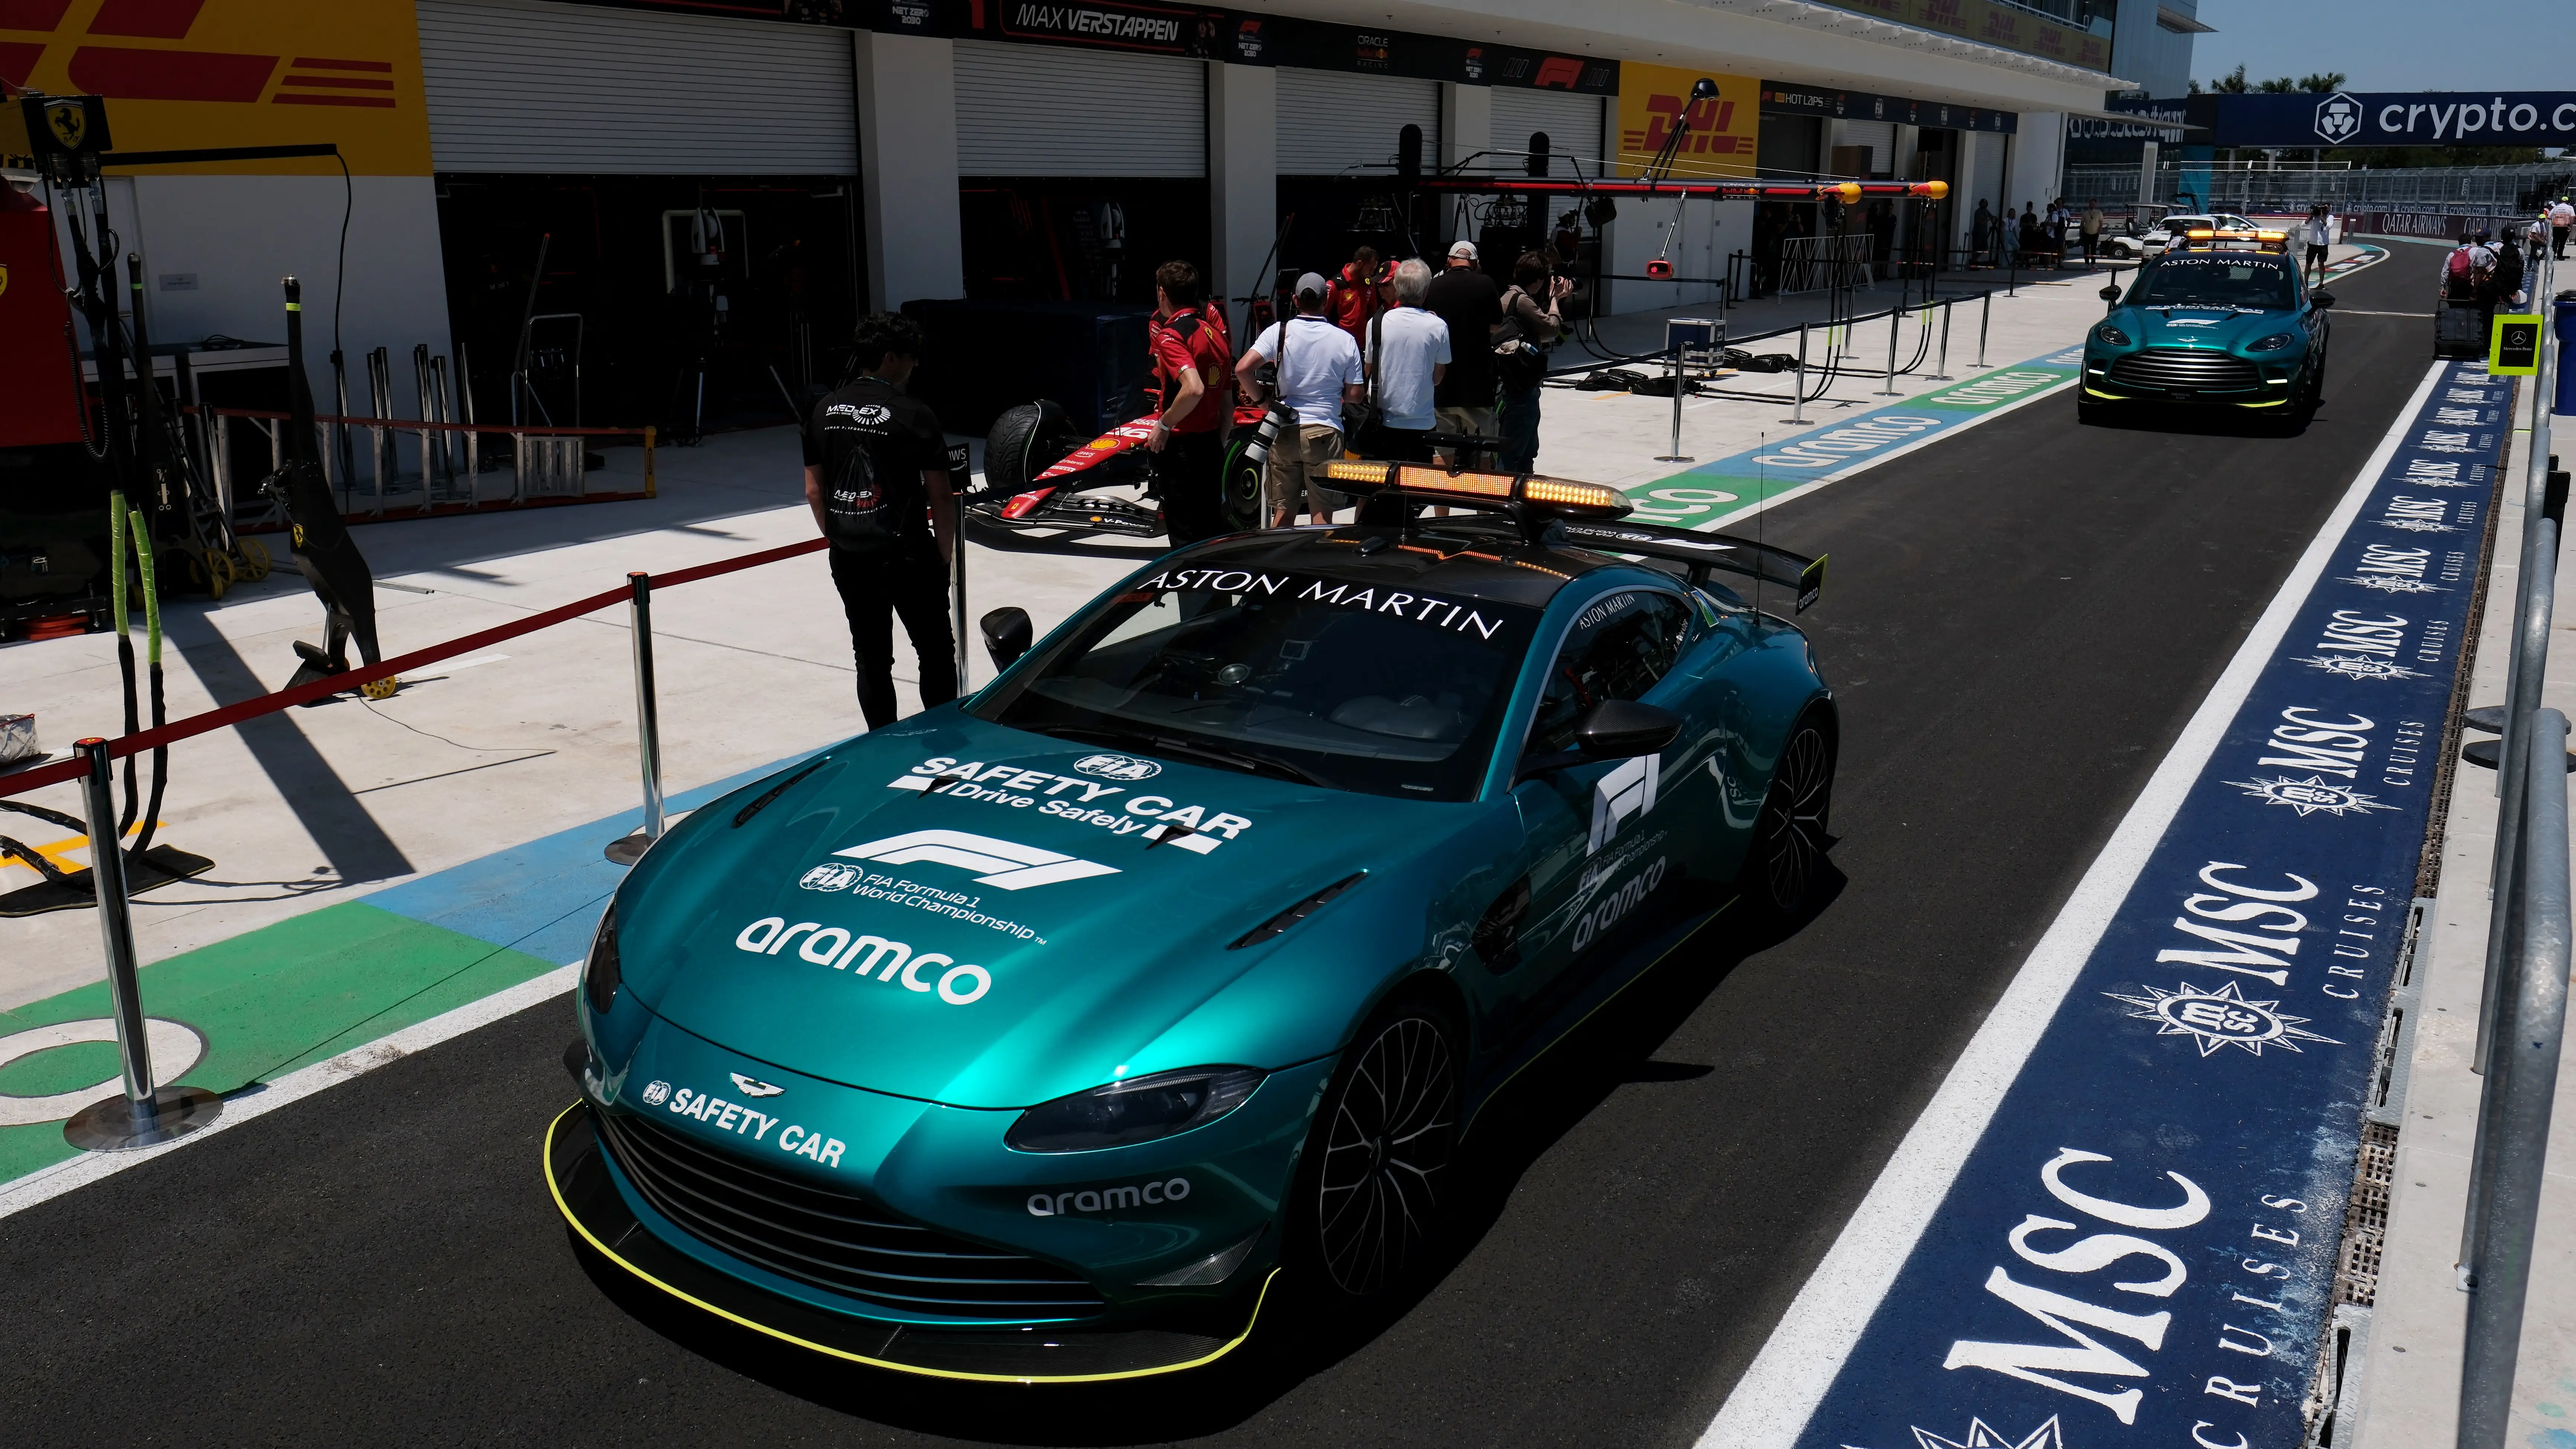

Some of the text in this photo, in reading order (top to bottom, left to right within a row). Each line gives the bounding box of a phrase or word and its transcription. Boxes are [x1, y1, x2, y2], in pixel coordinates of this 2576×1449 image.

[892, 6, 907, 15] NET
[902, 15, 921, 25] 2030
[1016, 3, 1179, 41] MAX VERSTAPPEN
[1358, 35, 1388, 47] ORACLE
[1357, 61, 1388, 69] RACING
[1785, 93, 1802, 104] HOT
[1643, 94, 1738, 153] DHL
[2383, 213, 2447, 235] QATAR AIRWAYS
[2450, 207, 2486, 215] crypo.com
[2160, 259, 2279, 270] ASTON MARTIN
[1930, 371, 2062, 406] aramco
[1751, 415, 1942, 468] aramco
[2406, 458, 2461, 479] MSC
[1015, 493, 1039, 502] antander
[2385, 495, 2448, 521] MSC
[2457, 501, 2477, 523] CRUISES
[1103, 518, 1152, 528] V-Power
[2357, 543, 2431, 578] MSC
[2440, 551, 2466, 582] CRUISES
[1137, 569, 1503, 640] ASTON MARTIN
[1579, 593, 1635, 630] ASTON MARTIN
[1799, 587, 1819, 610] aramco
[2317, 609, 2408, 658] MSC
[2417, 619, 2449, 662] CRUISES
[2257, 705, 2375, 780] MSC
[2382, 719, 2425, 787] CRUISES
[911, 757, 1252, 840] SAFETY CAR
[949, 783, 1148, 835] Drive Safely
[852, 884, 906, 903] World
[864, 874, 980, 909] FIA Formula 1
[1572, 856, 1667, 953] aramco
[2156, 860, 2319, 987] MSC
[2322, 883, 2385, 1000] CRUISES
[734, 914, 993, 1006] aramco
[669, 1088, 779, 1140] SAFETY
[778, 1125, 847, 1168] CAR
[1027, 1178, 1190, 1217] aramco
[1942, 1146, 2211, 1425] MSC
[2192, 1193, 2307, 1449] CRUISES
